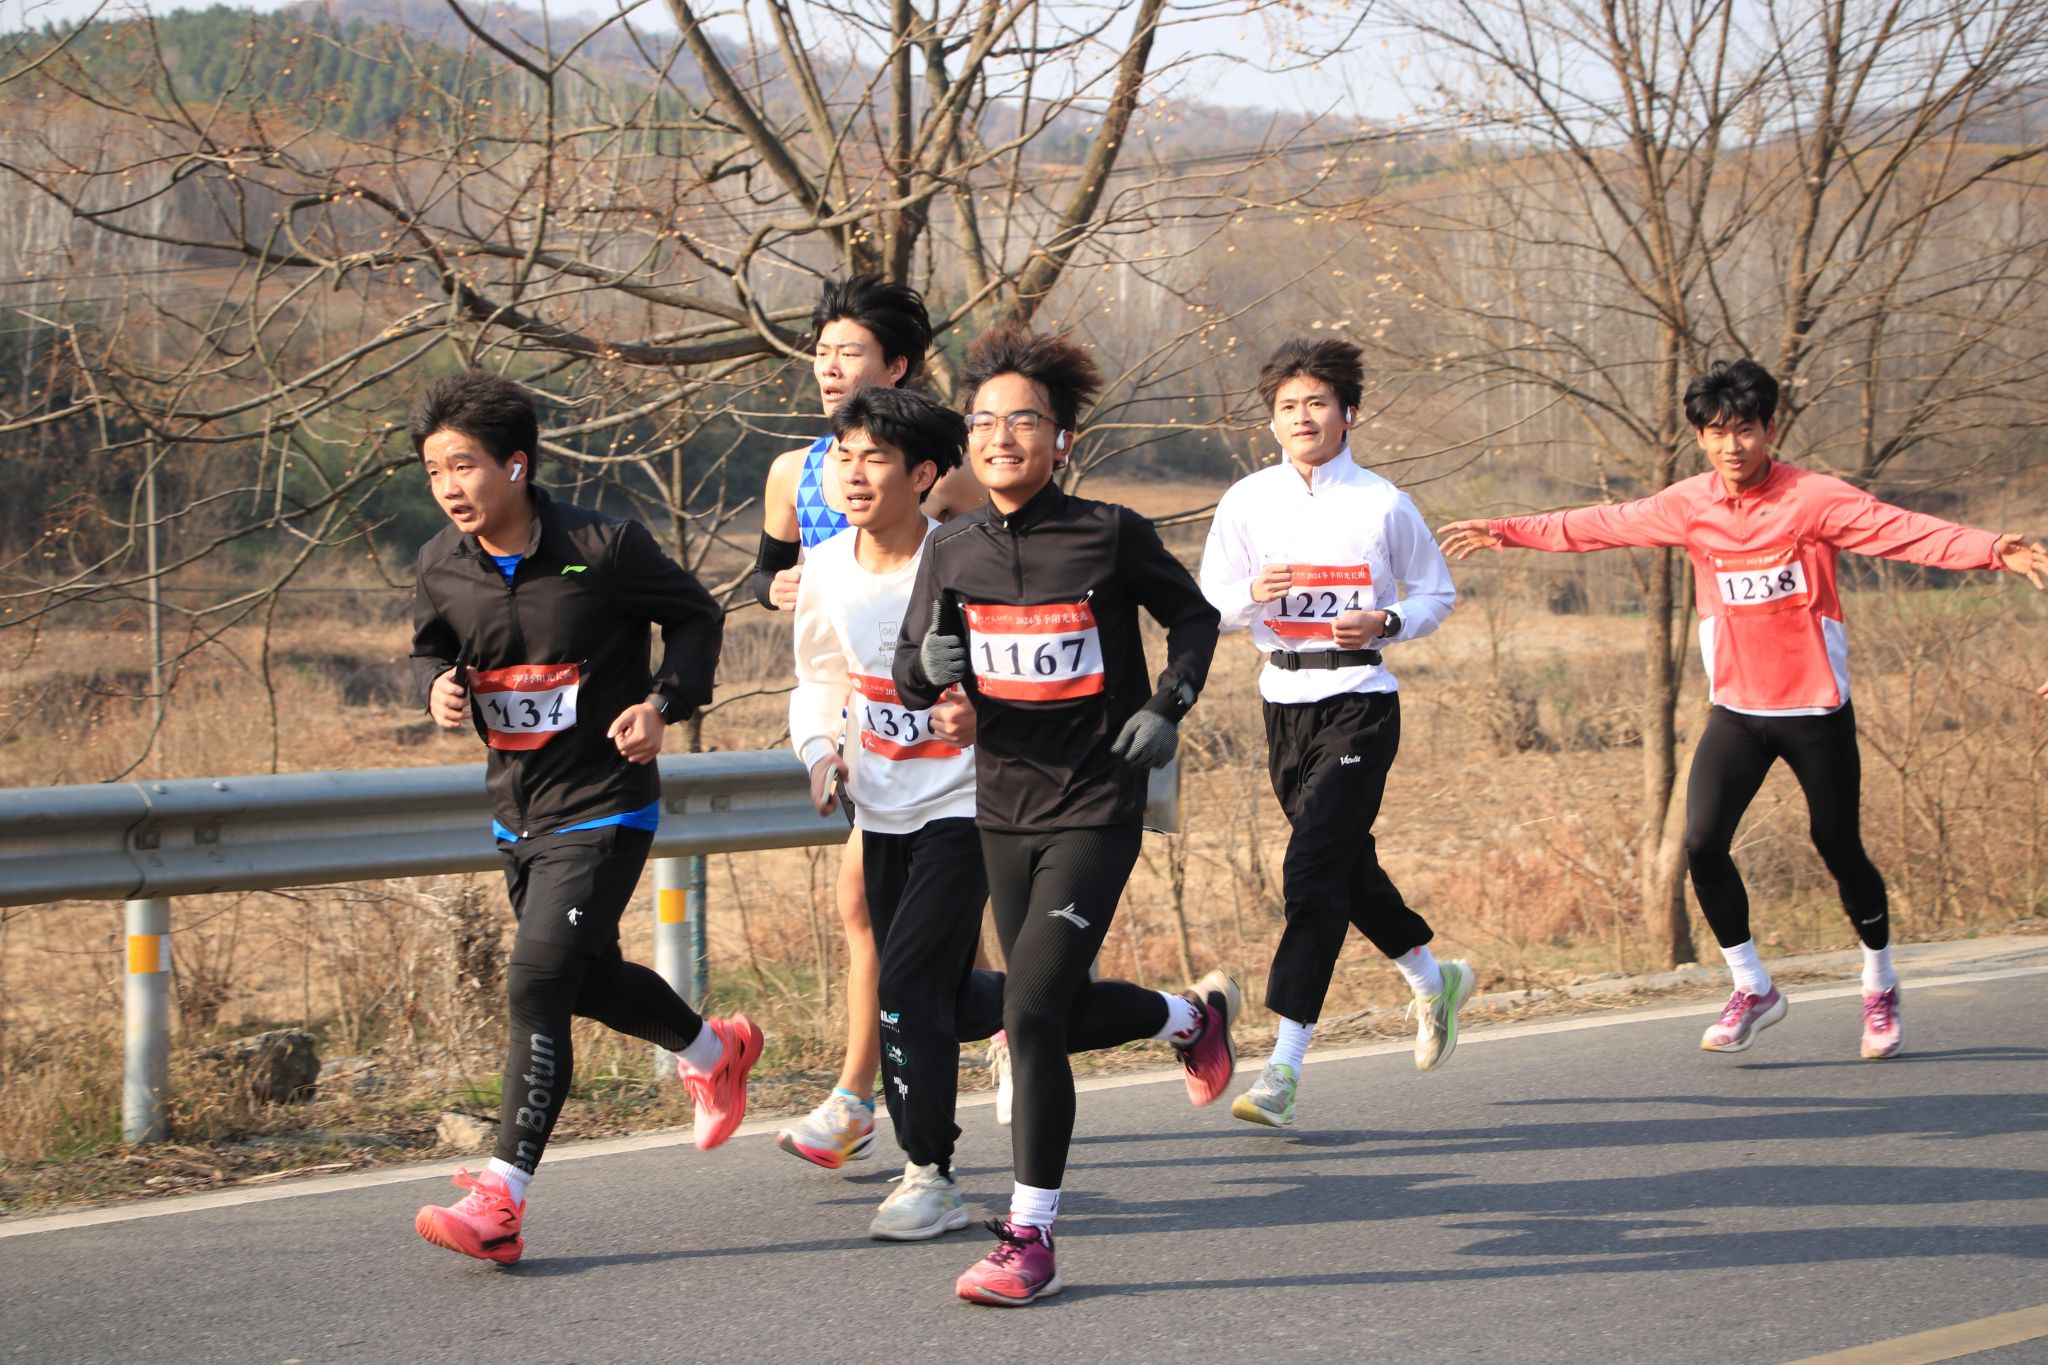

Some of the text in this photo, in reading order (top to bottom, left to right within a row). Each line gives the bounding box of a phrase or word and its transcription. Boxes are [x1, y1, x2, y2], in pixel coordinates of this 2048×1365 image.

[1725, 570, 1796, 601] 1238
[1277, 590, 1363, 618] 1224
[980, 637, 1086, 677] 1167
